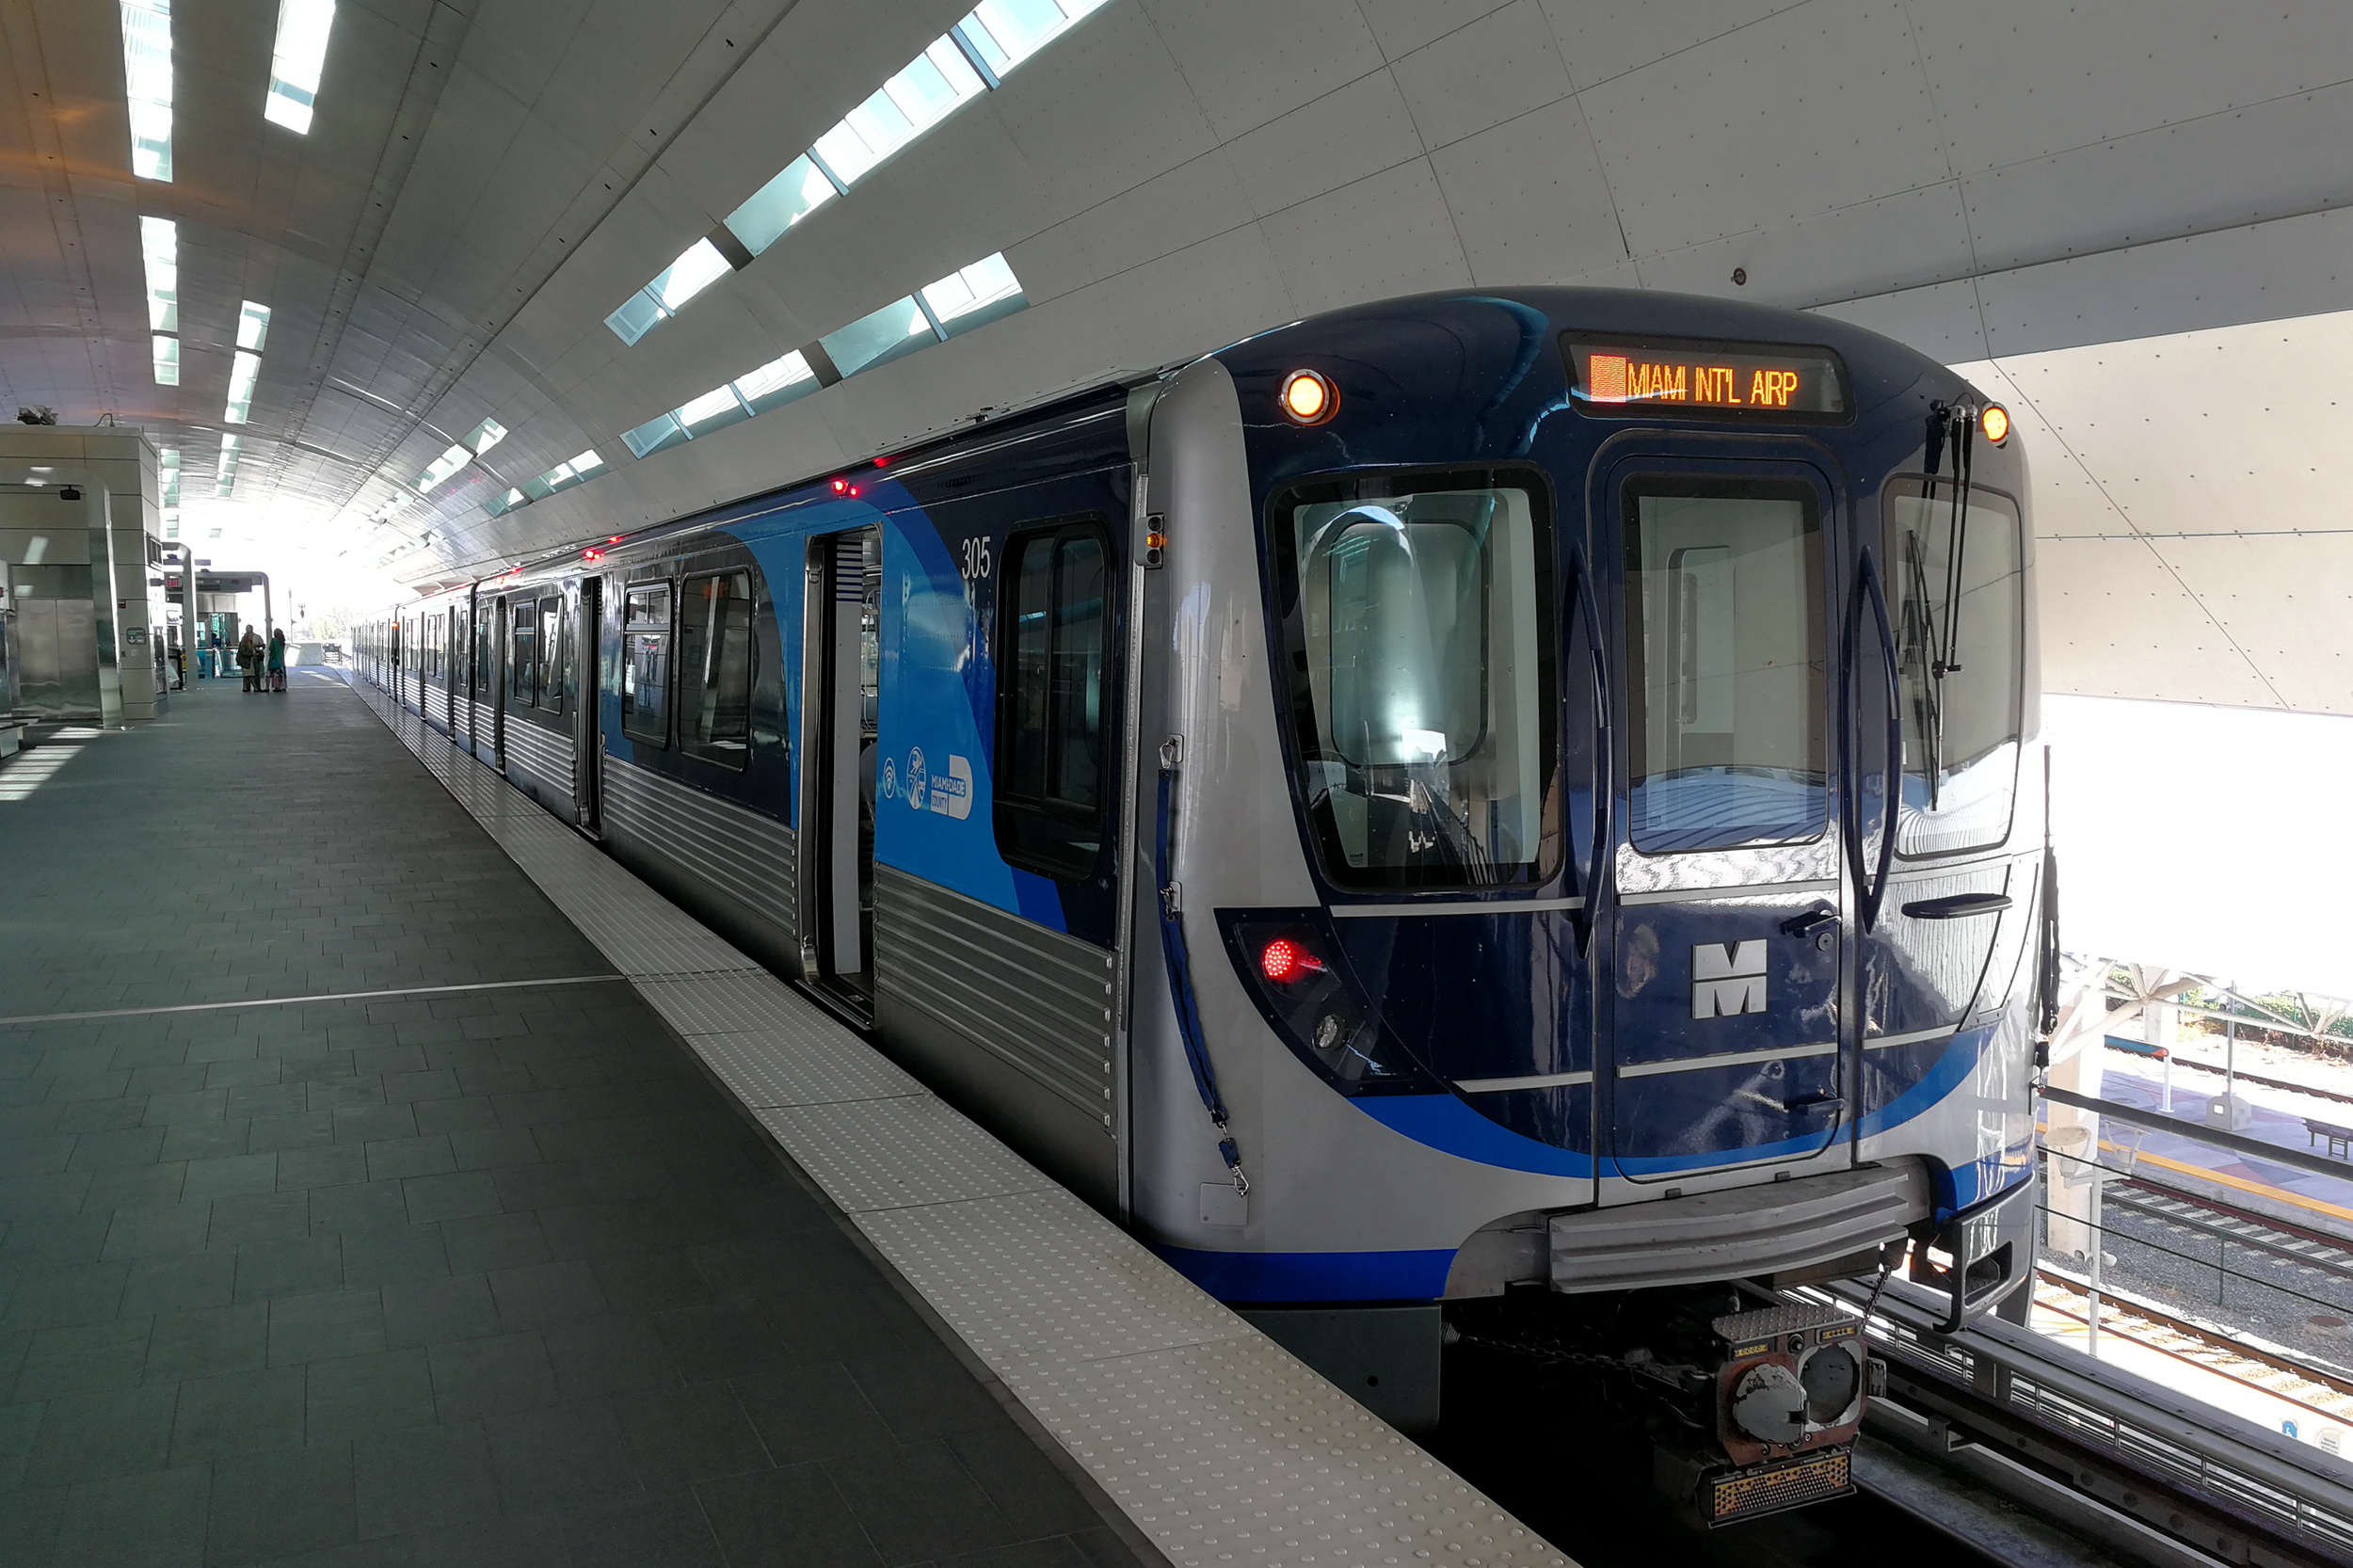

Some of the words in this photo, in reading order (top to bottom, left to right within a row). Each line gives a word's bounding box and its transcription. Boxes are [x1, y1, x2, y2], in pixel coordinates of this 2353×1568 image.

[1627, 362, 1687, 401] MIAMI
[1695, 366, 1741, 404] INT'L
[1750, 370, 1799, 407] AIRP
[962, 536, 991, 580] 305
[931, 774, 966, 796] MIAMI-DADE
[932, 794, 947, 810] COUNTY
